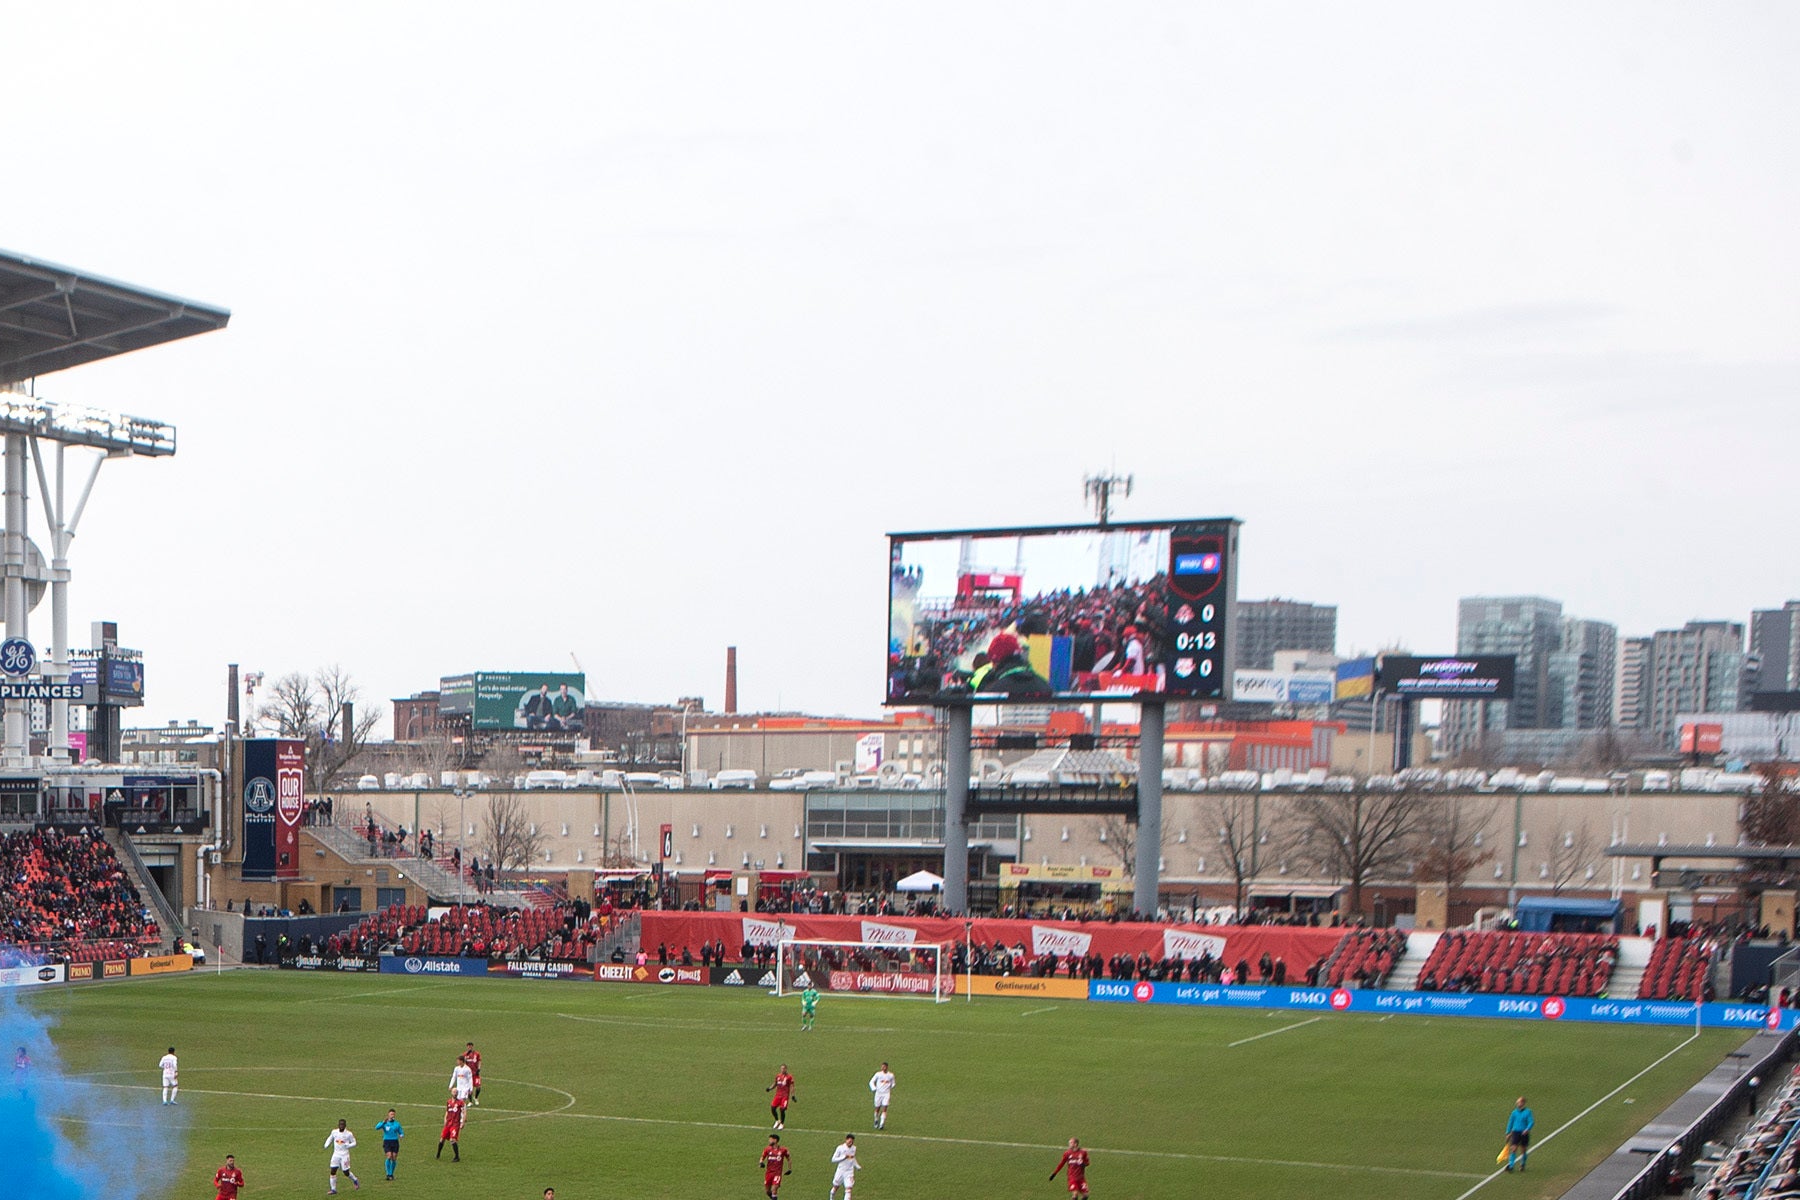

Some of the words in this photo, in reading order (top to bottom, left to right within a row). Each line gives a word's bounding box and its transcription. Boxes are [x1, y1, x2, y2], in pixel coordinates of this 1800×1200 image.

[1202, 604, 1214, 622] 0
[1176, 632, 1216, 650] 0:13
[1200, 659, 1212, 677] 0
[282, 778, 299, 796] OUR
[282, 797, 299, 808] HOUSE
[665, 832, 670, 856] 6
[748, 924, 775, 936] Mill
[867, 927, 893, 941] Mill
[1038, 933, 1067, 946] Mill
[1172, 935, 1201, 948] Mill
[105, 963, 125, 974] PRIMO
[150, 960, 172, 969] Continental
[422, 961, 460, 972] Allstate
[507, 961, 546, 972] FALLSVIEW
[547, 962, 574, 973] CASINO
[71, 967, 91, 977] PRIMO
[677, 969, 701, 981] PRINGLES
[857, 973, 890, 991] Captain
[891, 973, 929, 992] Morgan
[995, 981, 1040, 990] Continental
[1097, 985, 1130, 997] BMO
[1177, 988, 1199, 999] Let's
[1203, 990, 1219, 1000] get
[1290, 992, 1326, 1004] BMO
[1376, 995, 1402, 1007] Let's
[1404, 996, 1423, 1009] get
[1499, 1000, 1538, 1014] BMO
[1591, 1003, 1618, 1016] Let's
[1620, 1004, 1642, 1018] get
